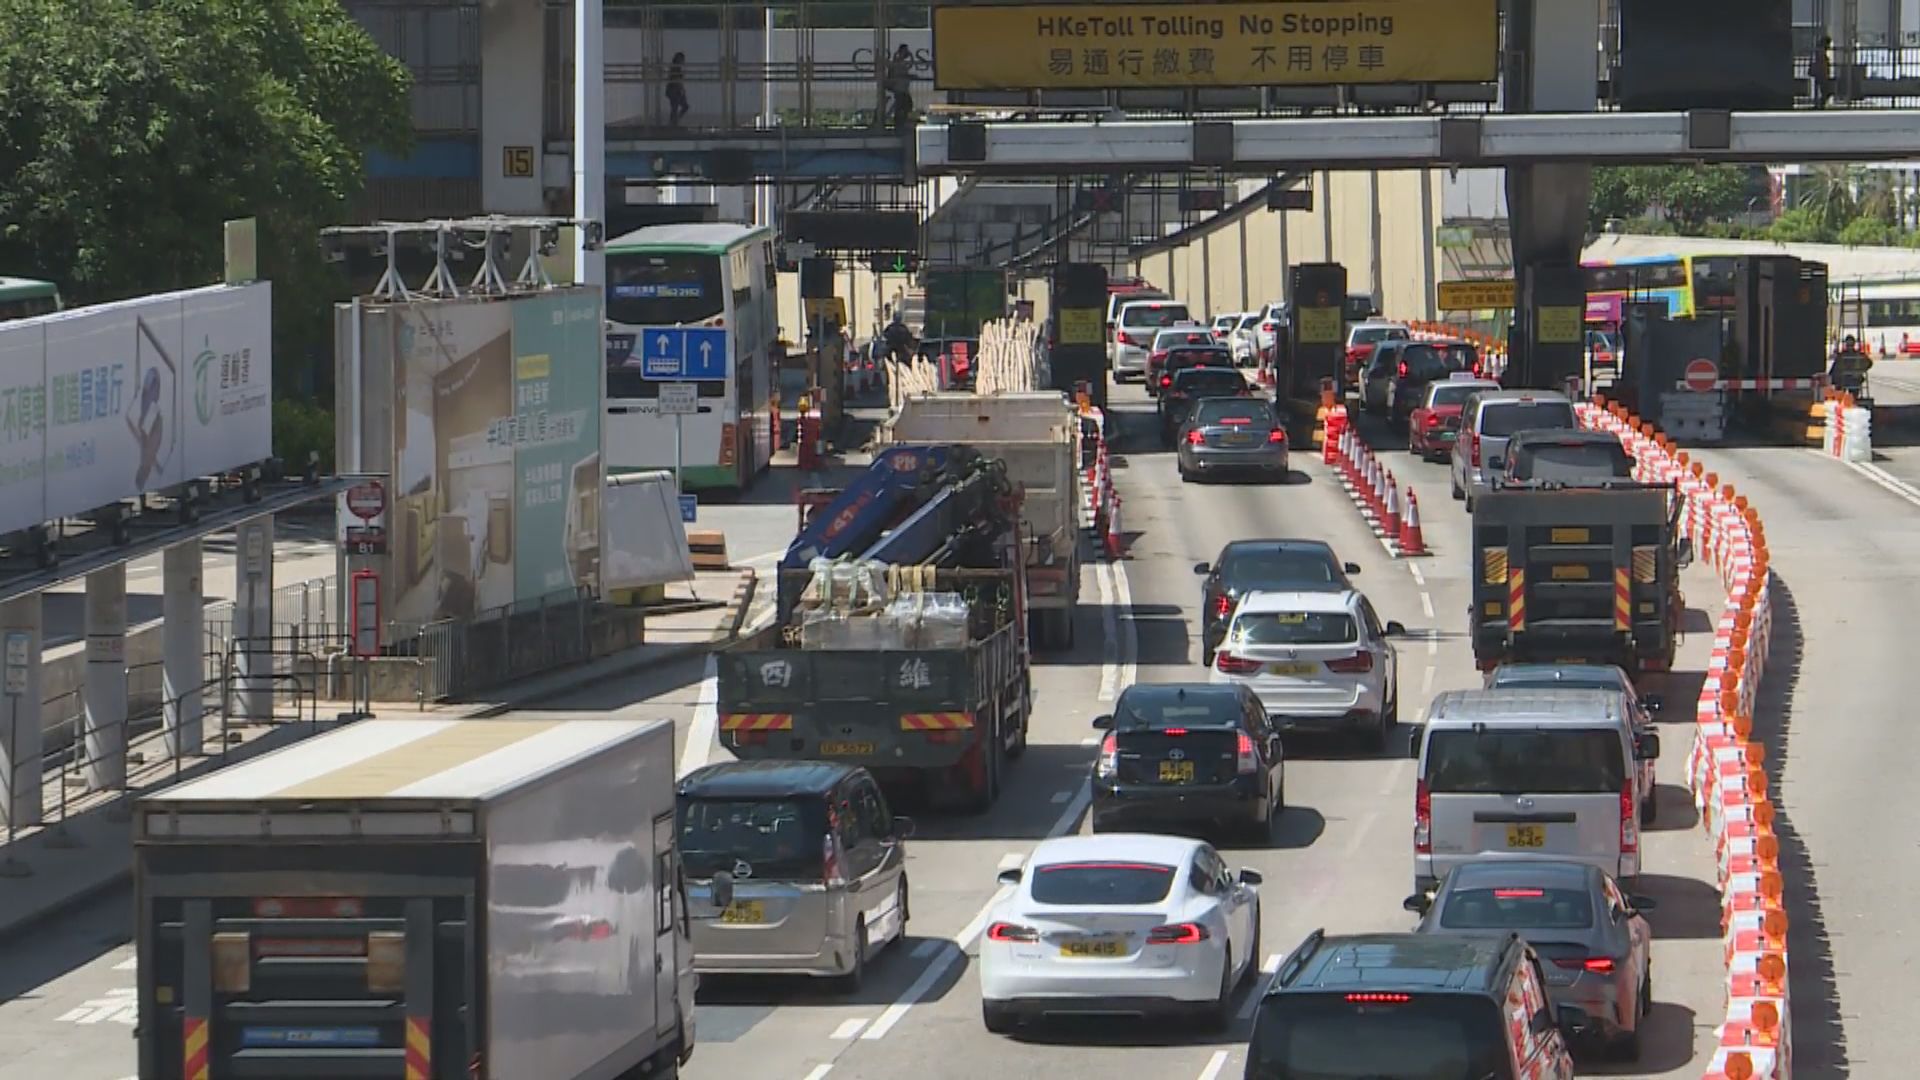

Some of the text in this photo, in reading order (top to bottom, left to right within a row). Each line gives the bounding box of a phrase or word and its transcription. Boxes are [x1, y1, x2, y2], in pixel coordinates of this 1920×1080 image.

[1038, 12, 1393, 39] HKeToll Tolling No Stopping
[1048, 45, 1385, 76] 易通行繳費 不用停車
[507, 150, 529, 173] 15
[359, 543, 374, 553] B1
[899, 657, 932, 690] 維
[1508, 837, 1544, 848] 5645
[1516, 826, 1534, 836] WS
